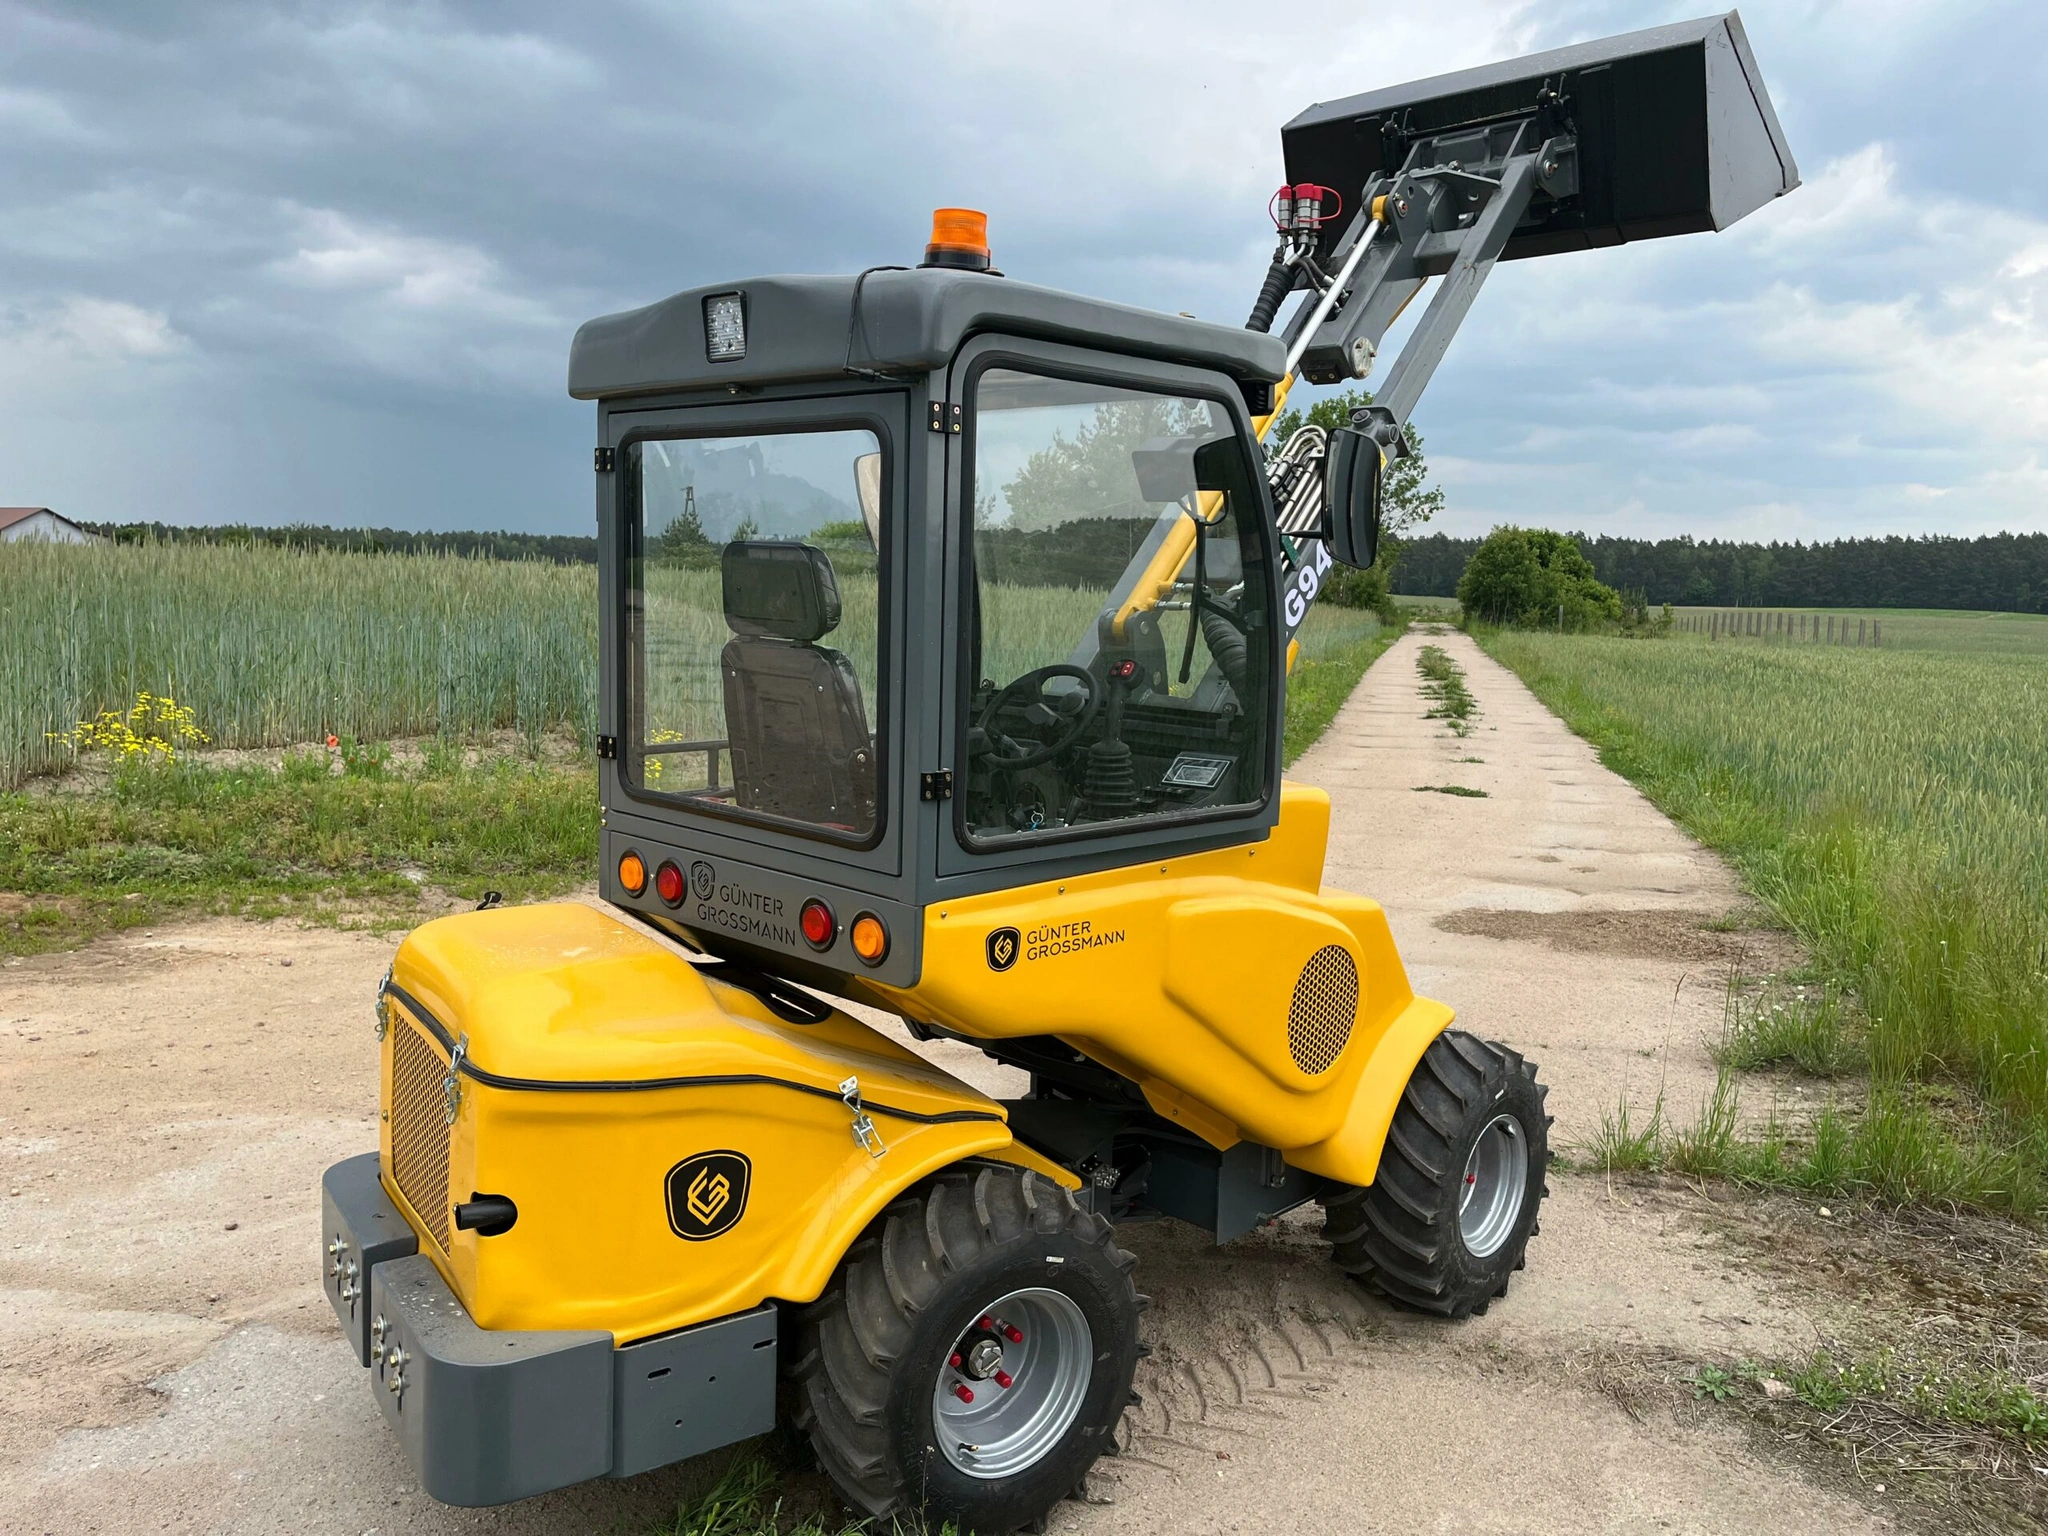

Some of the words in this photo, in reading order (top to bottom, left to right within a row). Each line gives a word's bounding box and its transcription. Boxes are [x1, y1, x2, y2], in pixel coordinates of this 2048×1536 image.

[720, 882, 783, 917] GÜNTER
[697, 903, 796, 947] GROSSMANN
[1026, 920, 1091, 945] GÜNTER
[1026, 929, 1125, 961] GROSSMANN
